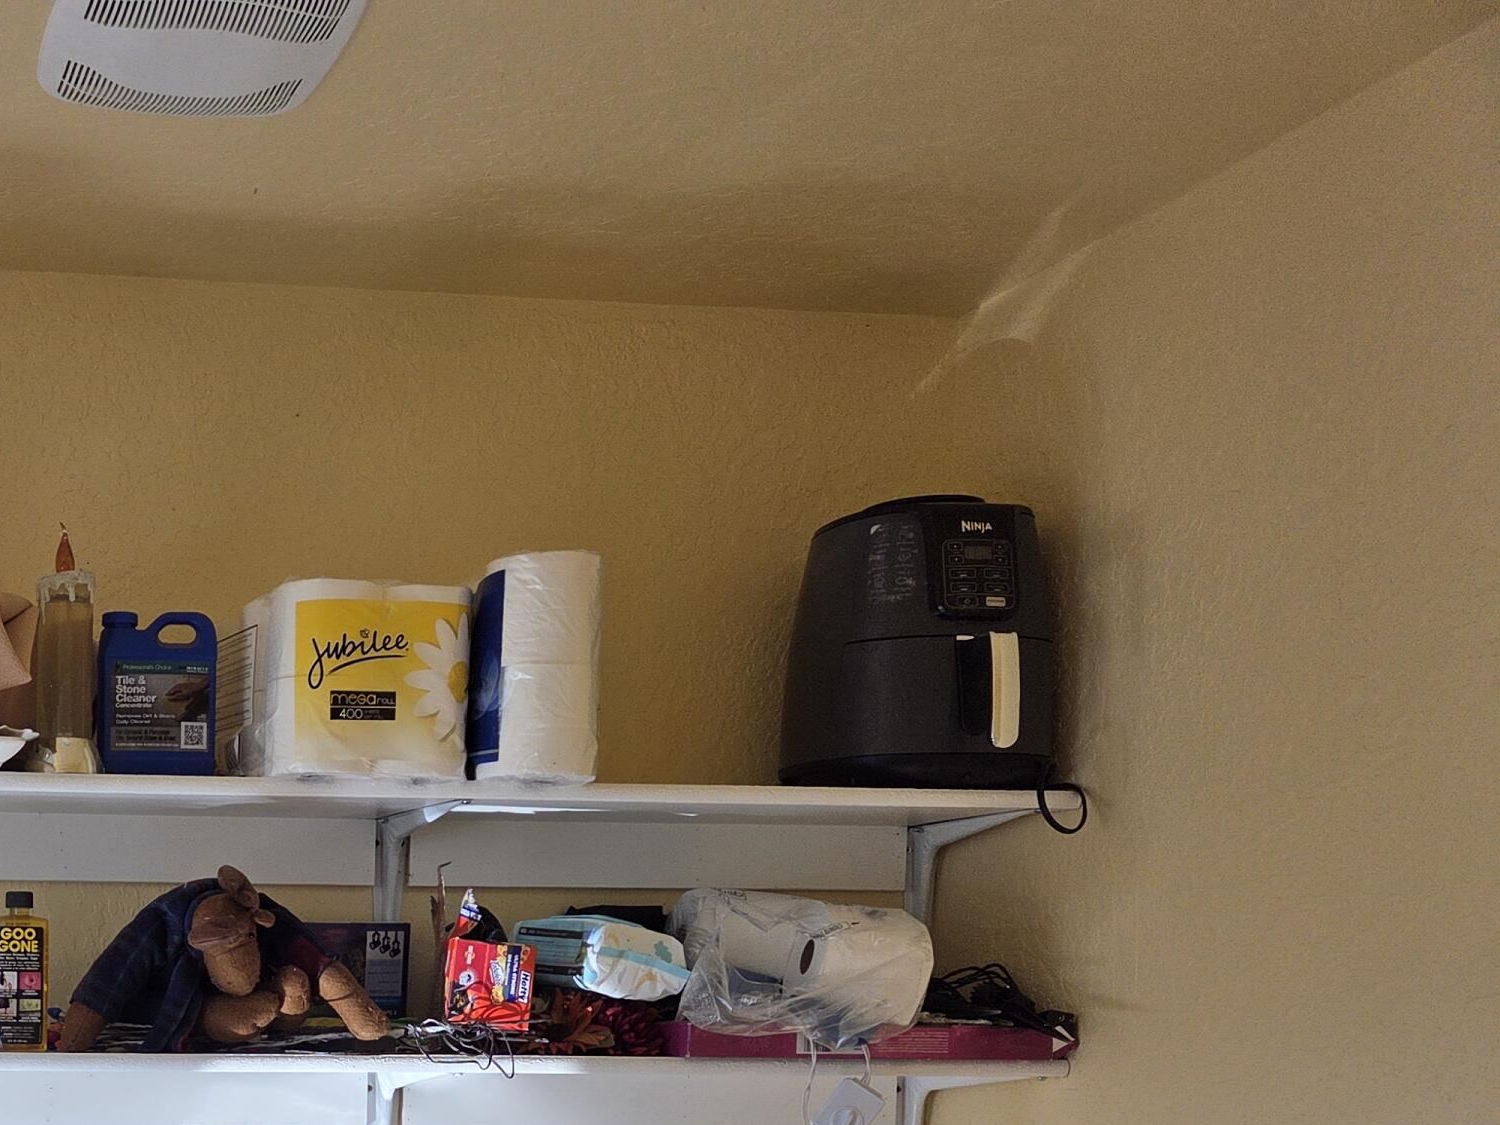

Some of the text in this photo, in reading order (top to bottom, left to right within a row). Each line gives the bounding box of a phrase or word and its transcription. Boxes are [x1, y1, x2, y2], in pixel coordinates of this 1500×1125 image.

[961, 520, 993, 534] NINJA
[116, 675, 146, 684] Tile &
[116, 685, 146, 694] Stone
[116, 694, 157, 703] Cleaner
[340, 709, 363, 719] 400
[0, 927, 36, 940] GOO
[518, 973, 530, 1001] Hefty
